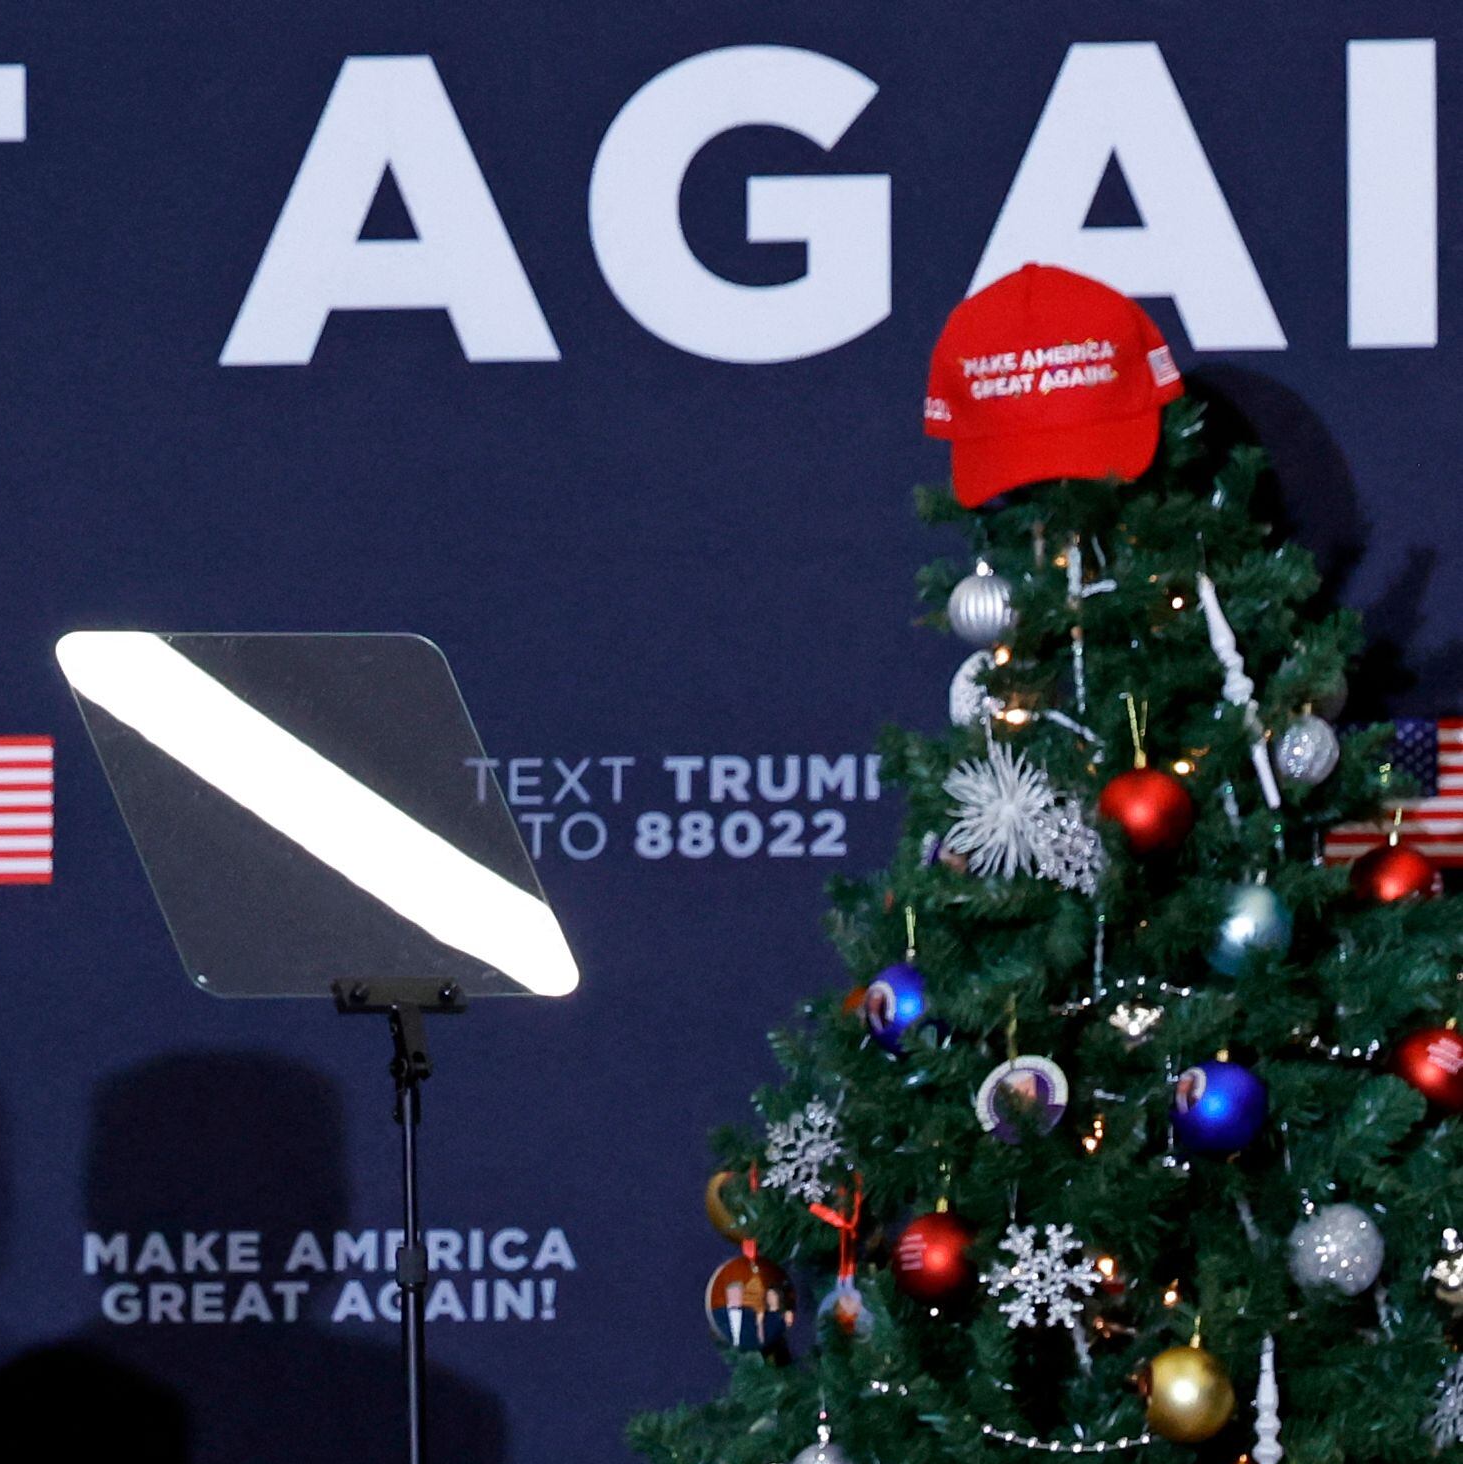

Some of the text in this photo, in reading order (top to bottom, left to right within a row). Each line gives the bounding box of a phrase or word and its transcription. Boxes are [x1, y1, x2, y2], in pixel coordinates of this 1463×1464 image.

[963, 340, 1116, 377] MAKE AMERICA
[971, 373, 1035, 400] GREAT
[463, 756, 636, 805] TEXT
[520, 809, 847, 861] TO 88022
[83, 1231, 261, 1275] MAKE
[101, 1278, 557, 1324] GREAT AGAIN!
